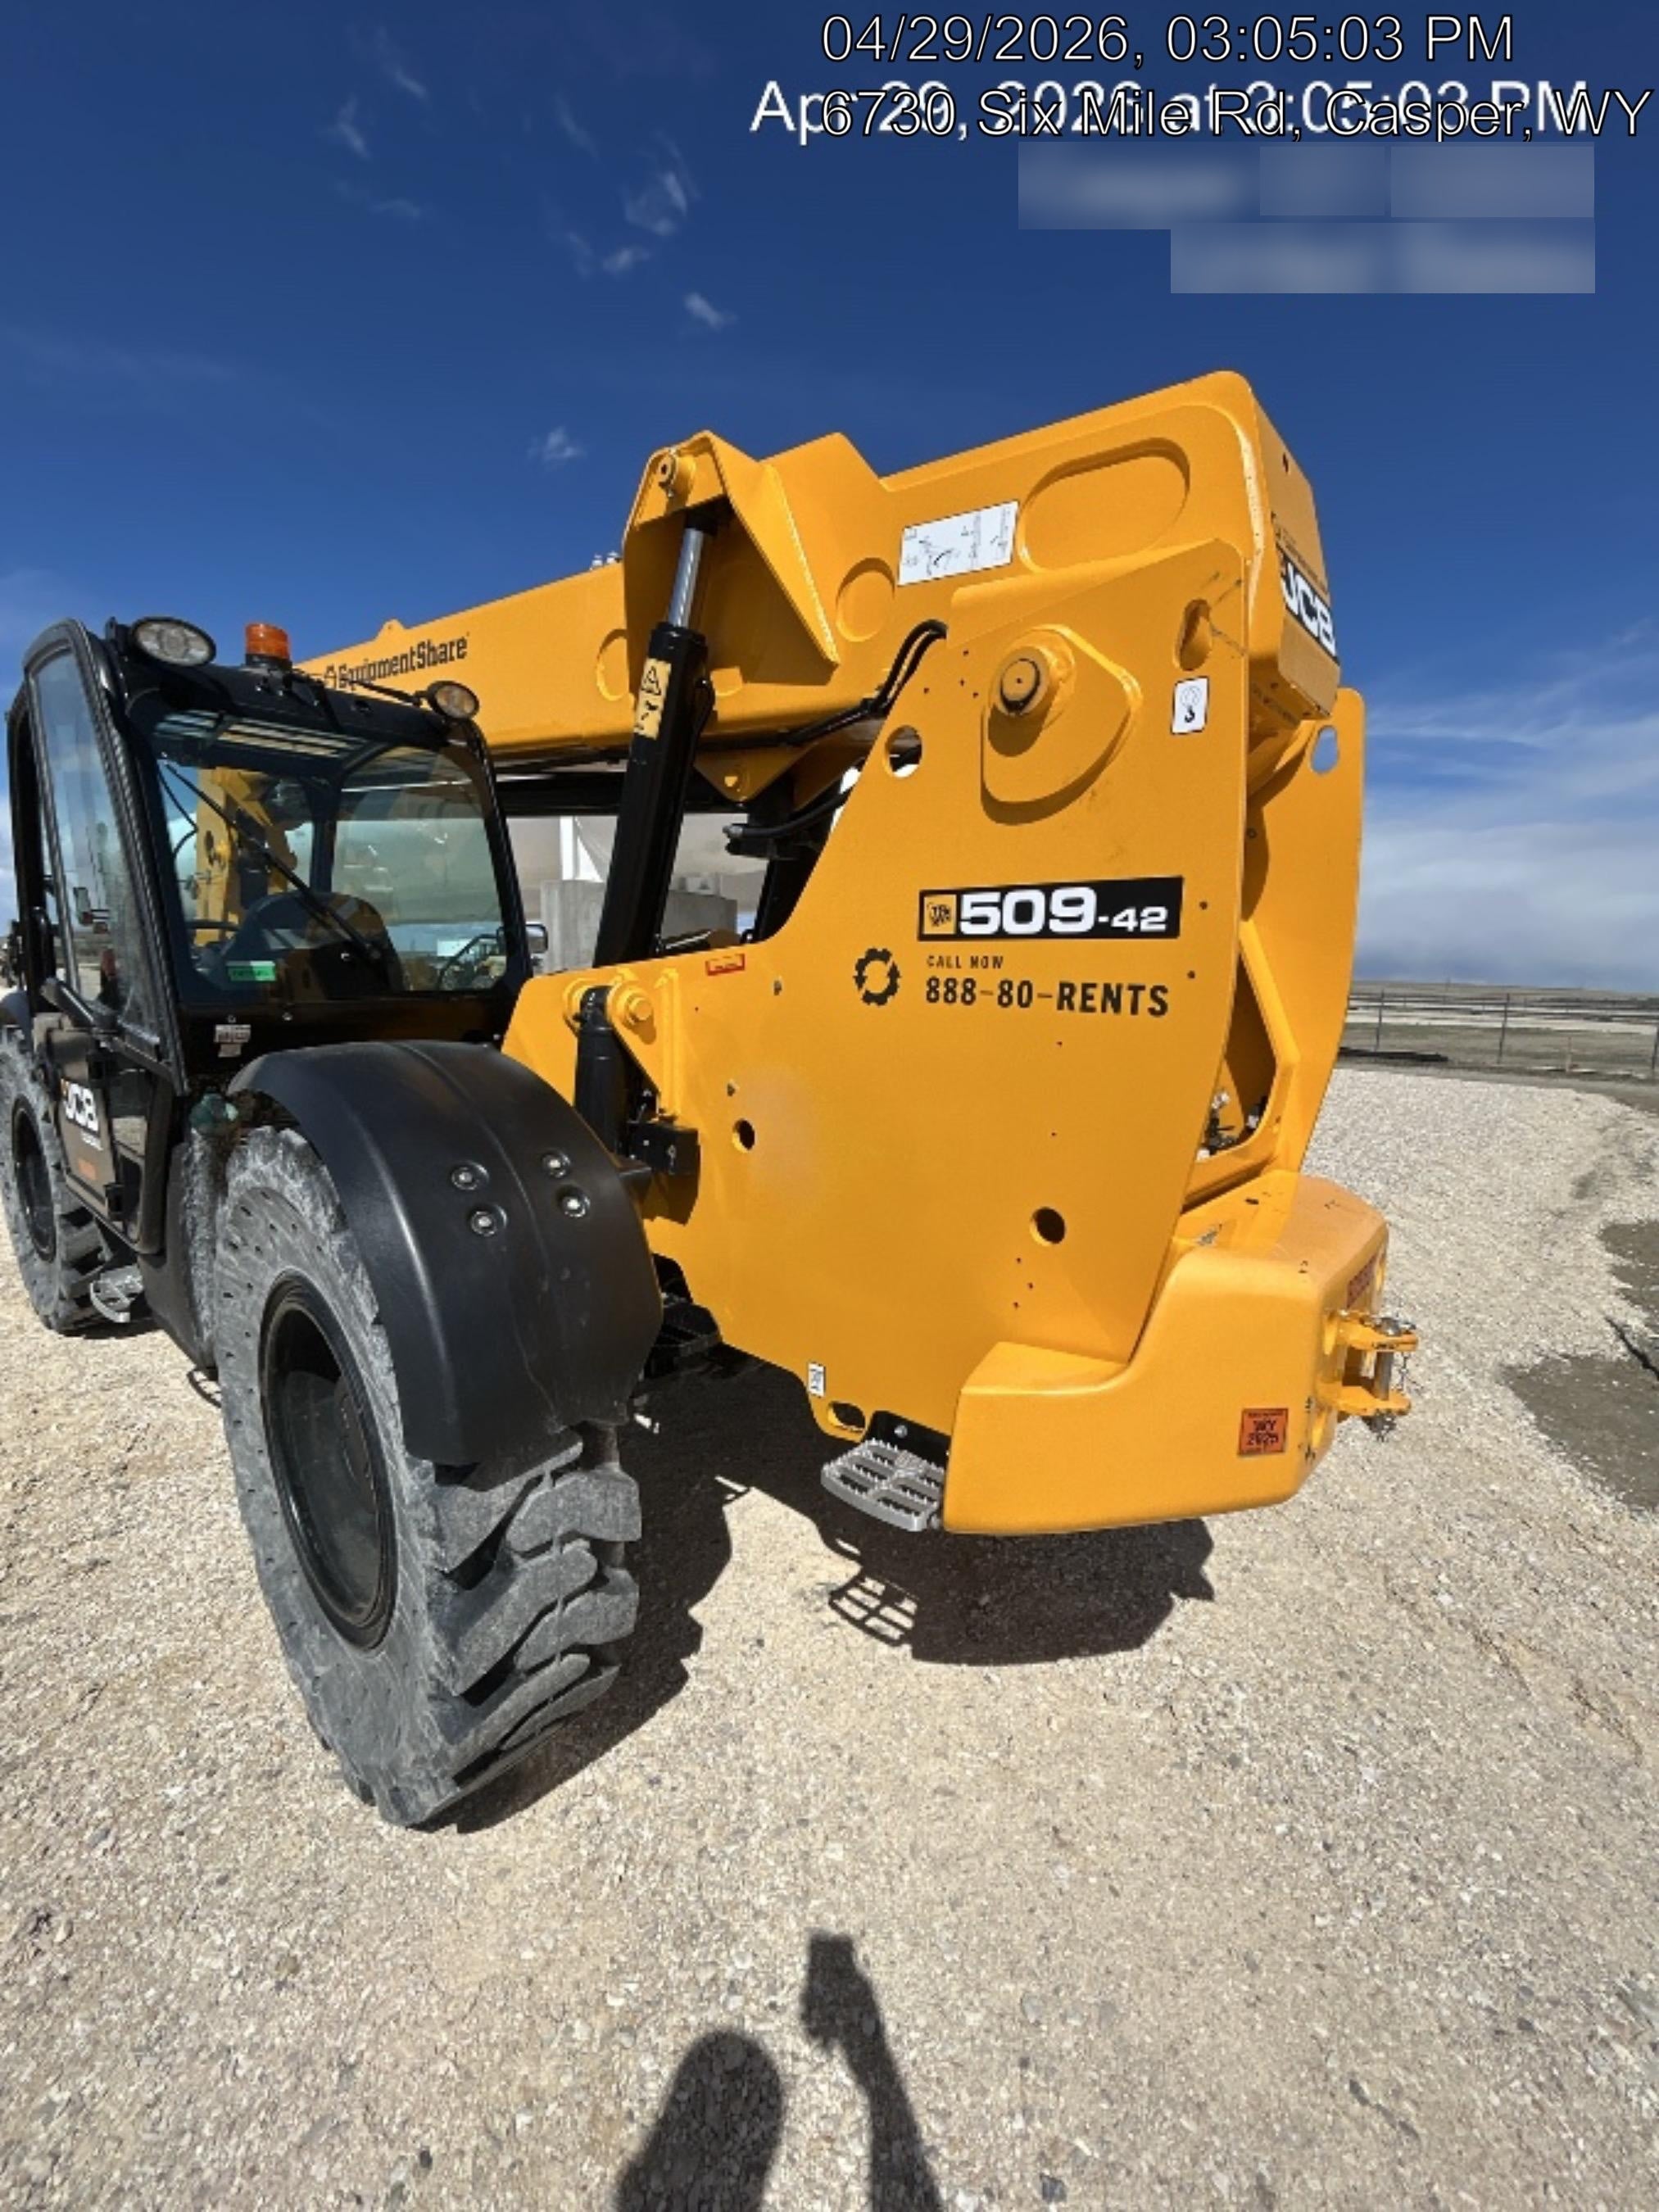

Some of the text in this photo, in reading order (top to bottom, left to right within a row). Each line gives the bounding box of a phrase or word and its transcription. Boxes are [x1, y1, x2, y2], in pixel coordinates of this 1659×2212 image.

[1281, 561, 1337, 657] JCB
[959, 886, 1169, 936] 509-42
[926, 955, 1004, 969] CALL NOW
[926, 976, 1170, 1018] 888-80-RENTS
[63, 1082, 99, 1131] JCB
